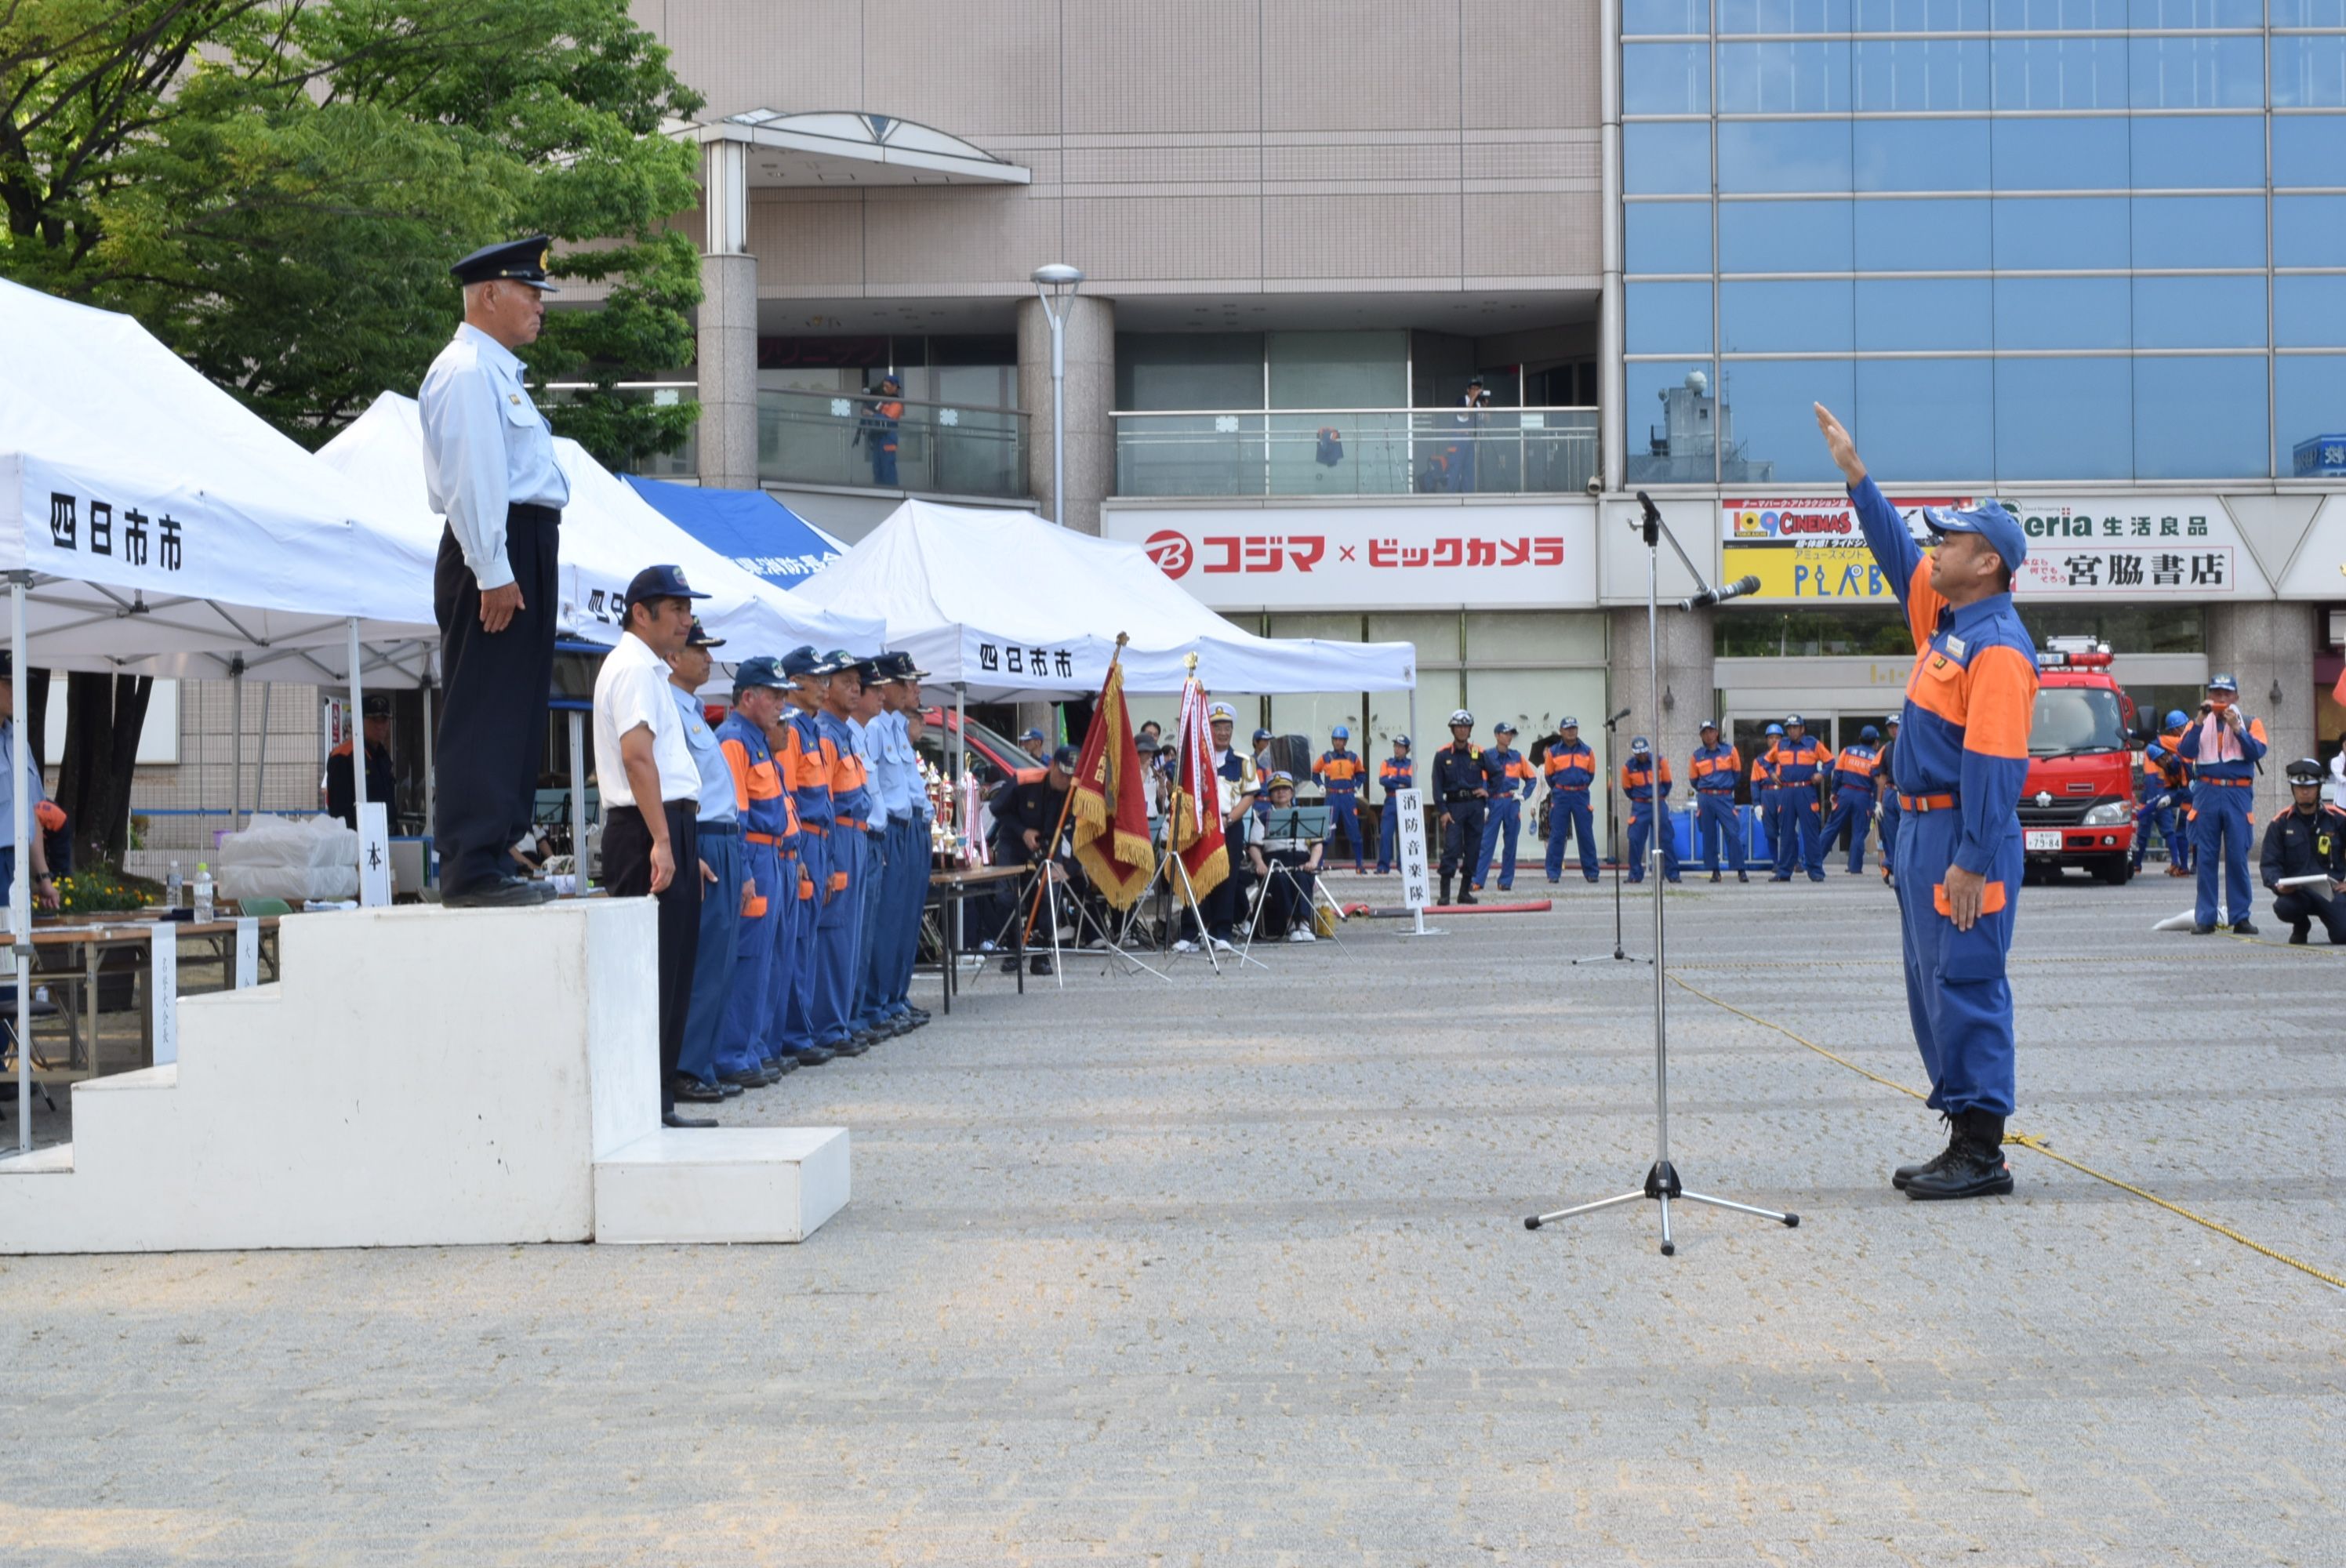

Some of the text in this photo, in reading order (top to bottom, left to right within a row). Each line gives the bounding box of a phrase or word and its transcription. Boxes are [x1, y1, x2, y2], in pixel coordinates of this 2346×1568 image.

[50, 491, 182, 572] 四日市市
[1734, 511, 1852, 537] 109 CINEMAS
[2103, 516, 2208, 536] 生活良品
[1203, 535, 1325, 574] コジマ
[1367, 538, 1564, 568] ビックカメラ
[1795, 550, 1865, 560] アミューズメント
[2064, 554, 2225, 586] 宮脇書店
[1795, 564, 1895, 596] PLAB
[980, 643, 1073, 678] 四日市市
[1338, 761, 1345, 776] 1
[1402, 794, 1424, 902] 消防音楽隊
